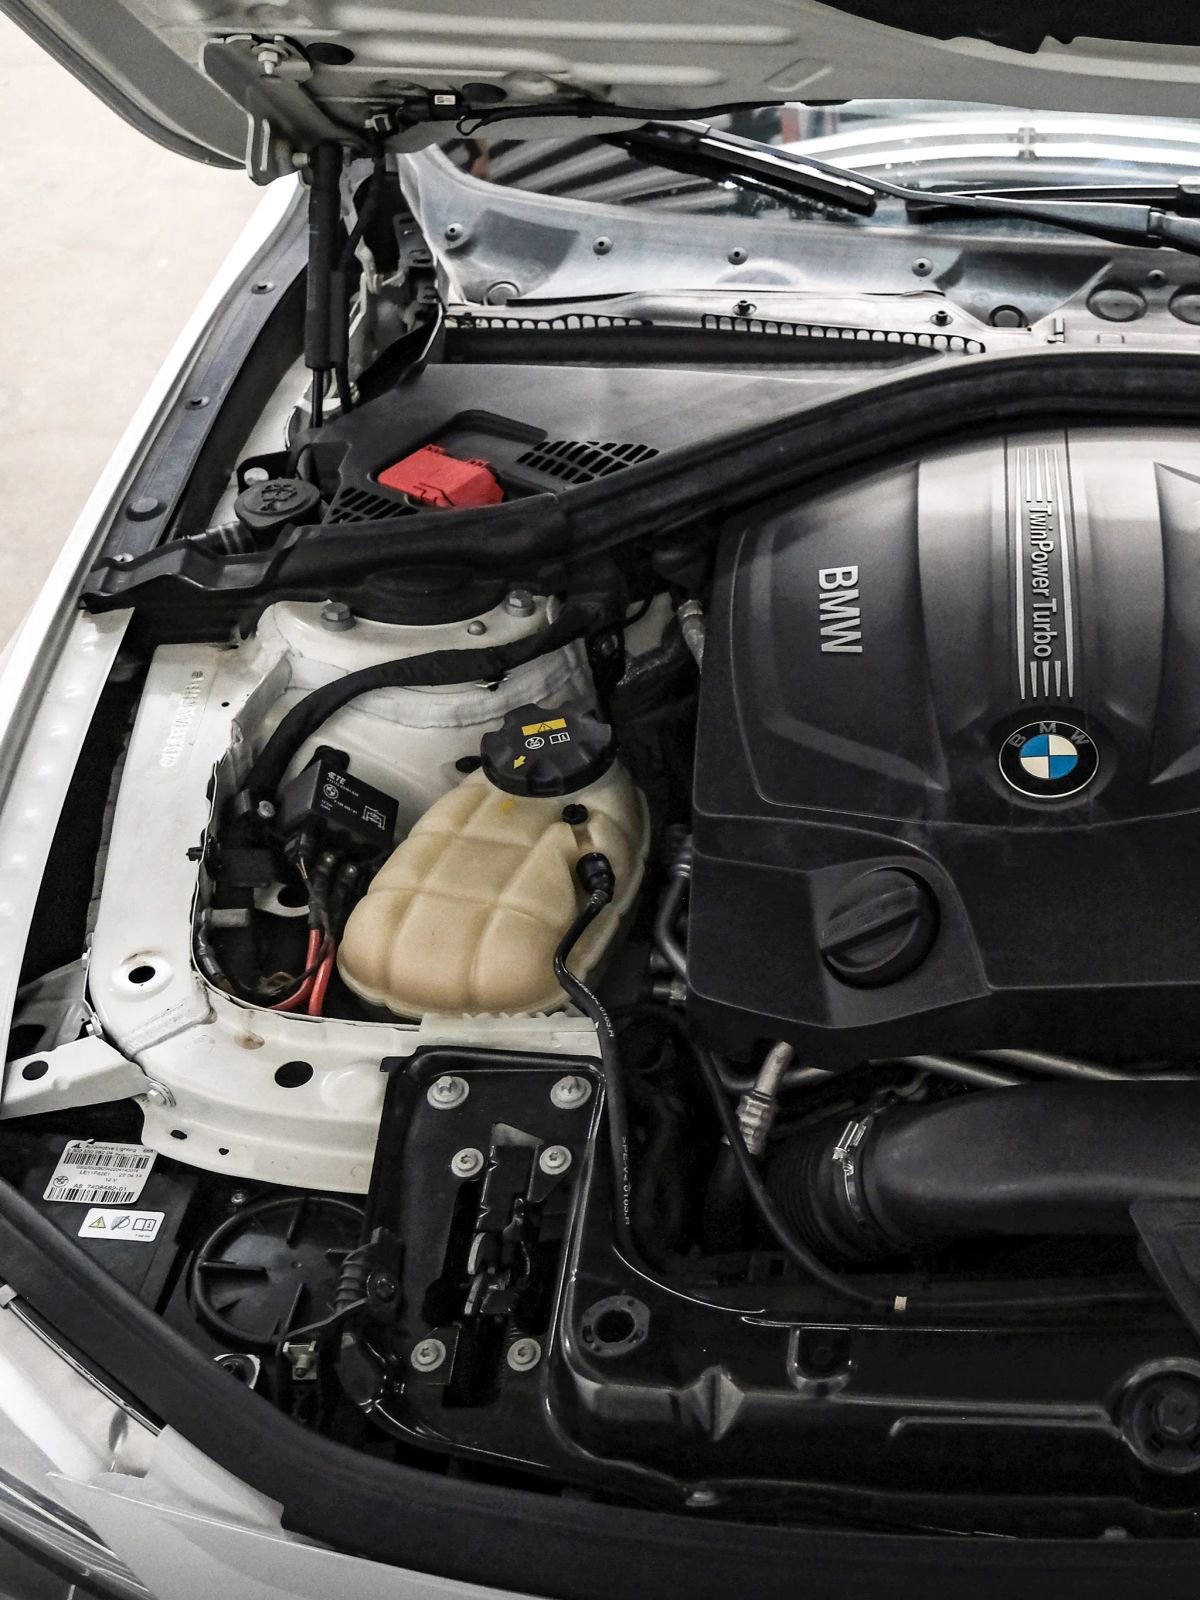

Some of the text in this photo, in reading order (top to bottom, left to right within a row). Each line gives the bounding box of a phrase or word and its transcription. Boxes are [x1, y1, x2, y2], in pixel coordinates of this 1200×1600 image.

[818, 565, 863, 653] BMW
[1029, 505, 1058, 658] TwinPower Turbo
[1008, 721, 1090, 748] BMW
